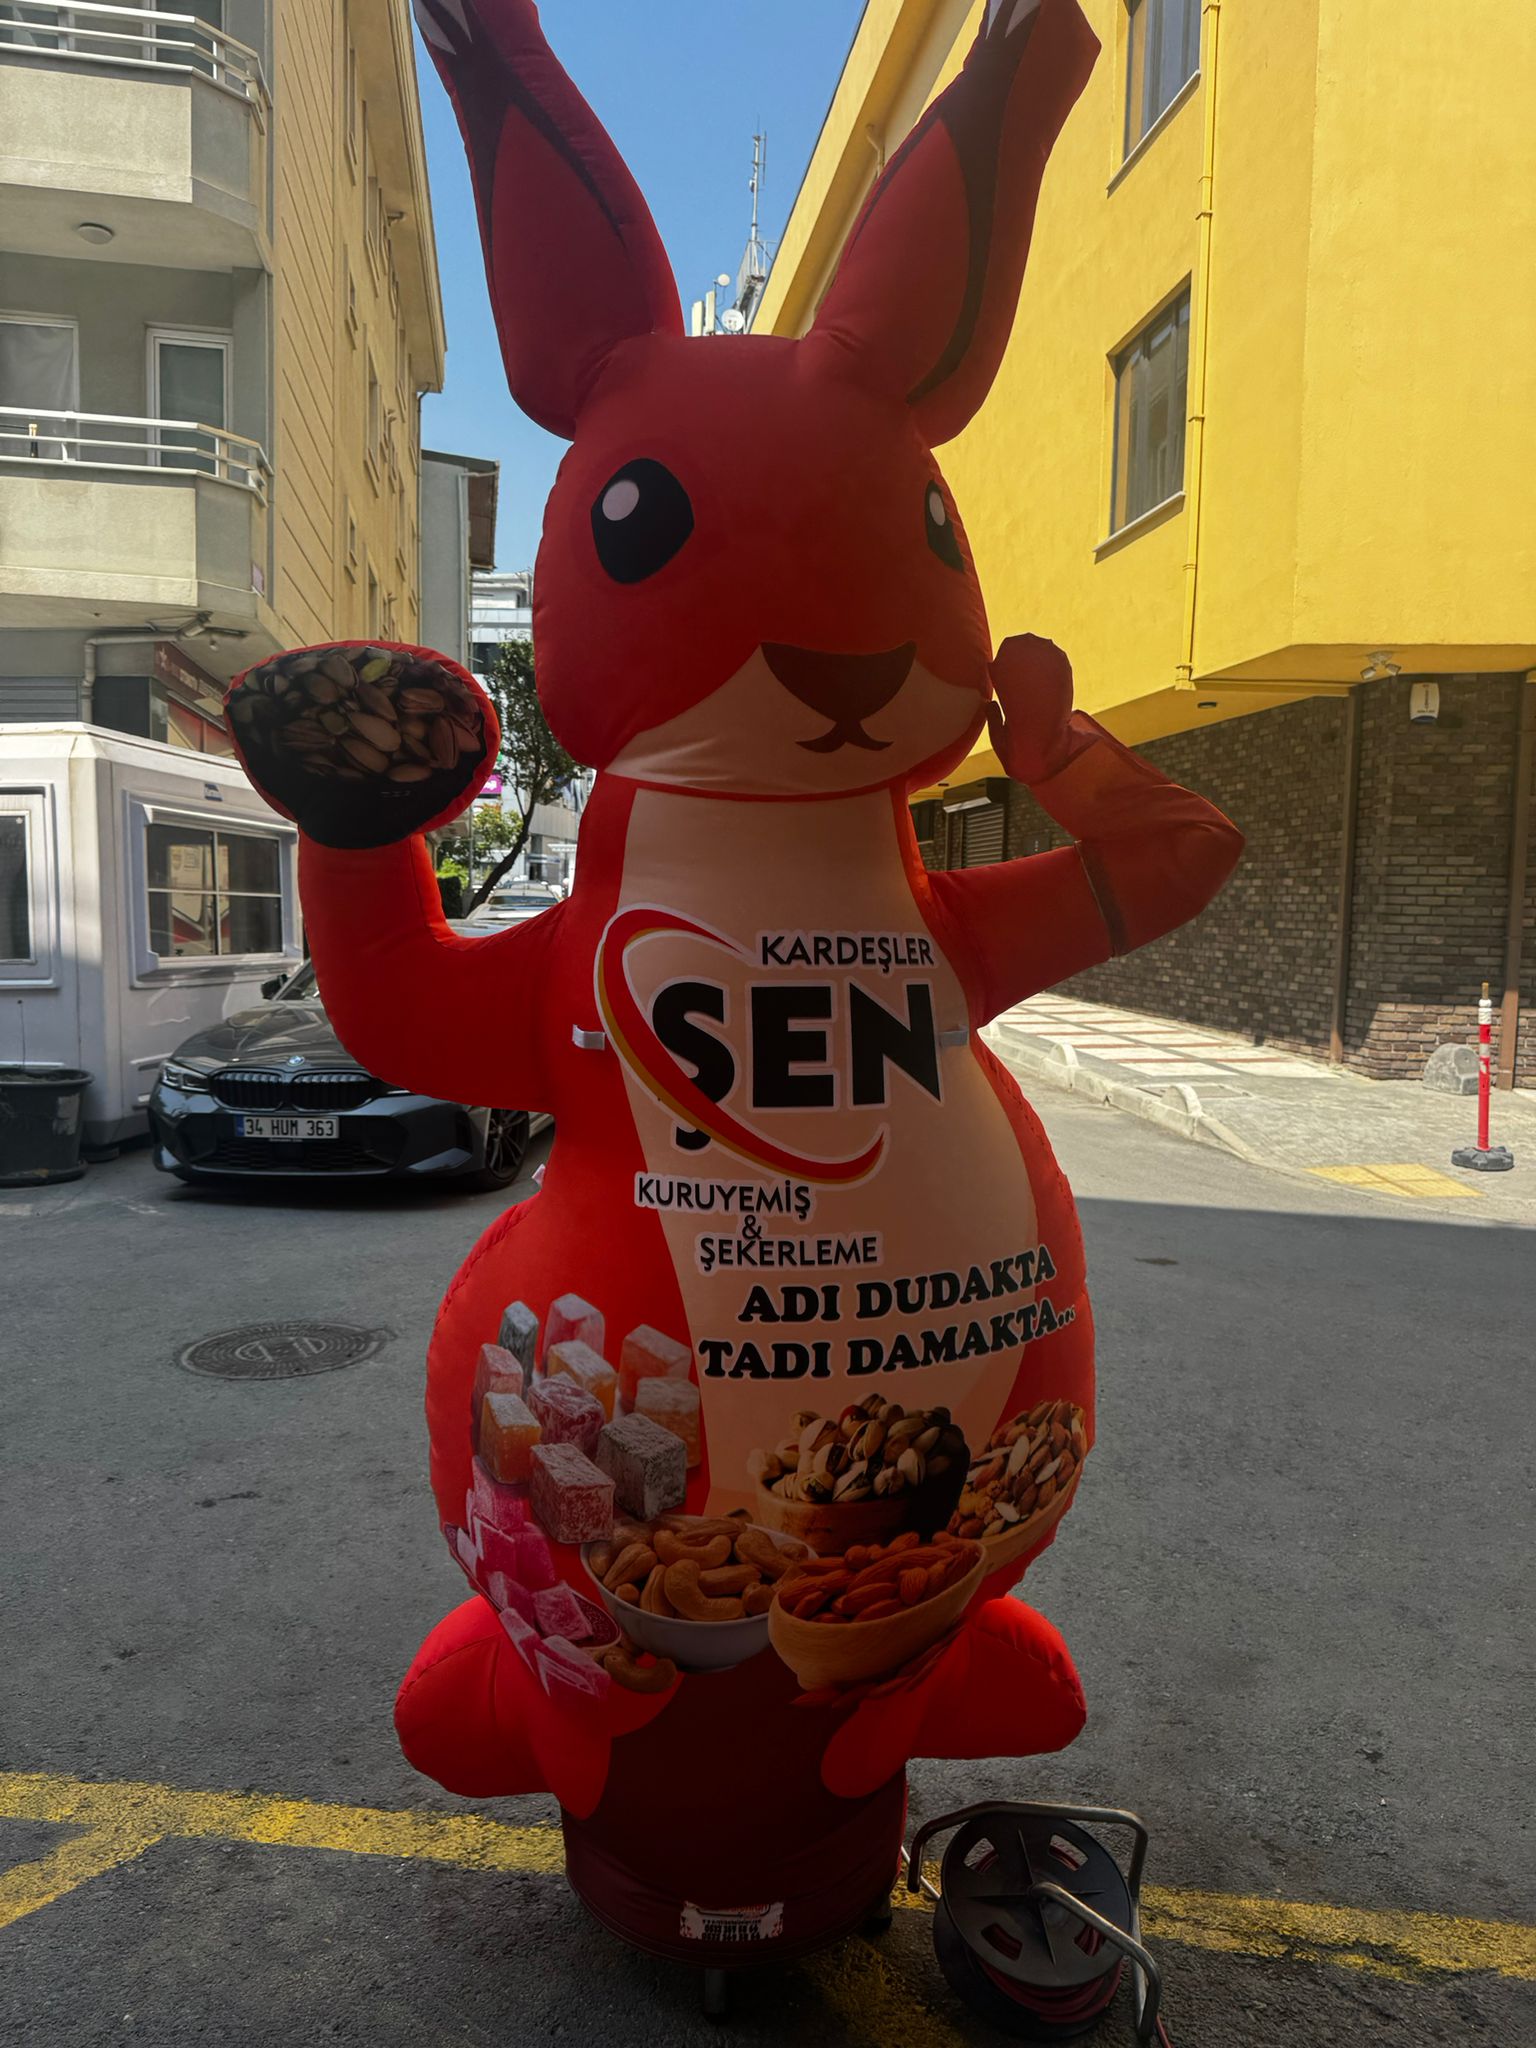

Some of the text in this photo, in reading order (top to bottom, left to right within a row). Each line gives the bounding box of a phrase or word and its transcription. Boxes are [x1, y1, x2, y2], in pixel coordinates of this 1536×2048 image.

[762, 936, 934, 974] KARDEŞLER
[652, 981, 942, 1150] ŞEN
[246, 1118, 335, 1137] 34 HUM 363
[638, 1177, 811, 1220] KURUYEMİŞ
[742, 1215, 762, 1241] &
[700, 1236, 878, 1271] ŞEKERLEME
[738, 1246, 1056, 1322] ADI DUDAKTA
[699, 1340, 831, 1378] TADI
